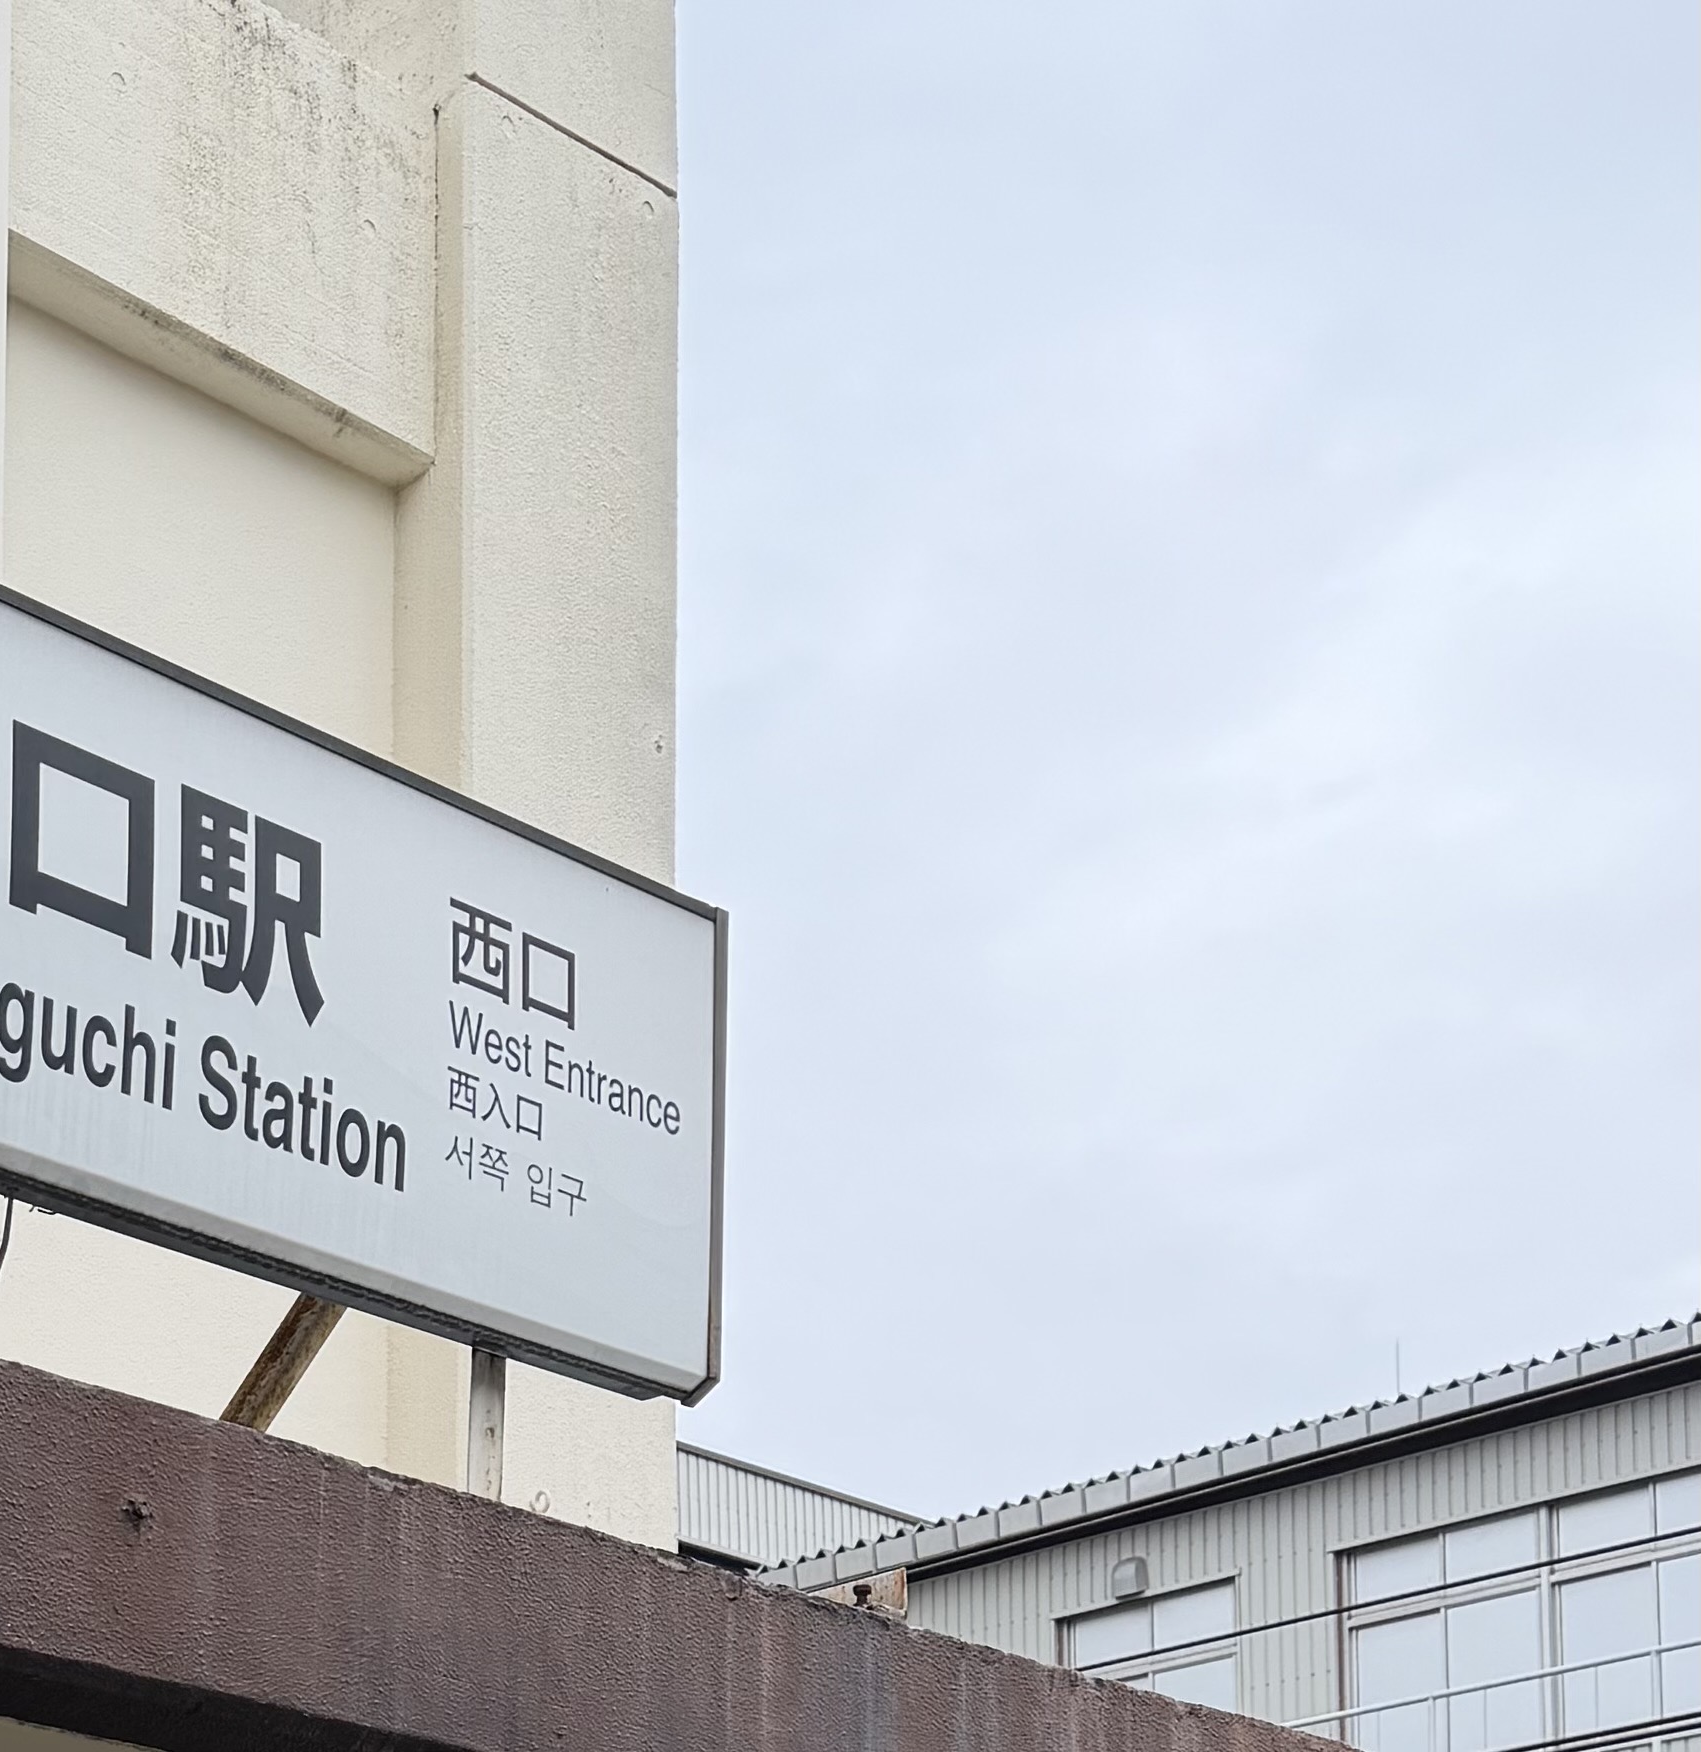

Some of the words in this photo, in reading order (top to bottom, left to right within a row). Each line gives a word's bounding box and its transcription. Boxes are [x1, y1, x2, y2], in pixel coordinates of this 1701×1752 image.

[449, 896, 576, 1031] 西口
[198, 1035, 406, 1192] Station
[447, 1065, 543, 1142] 西入口
[448, 1000, 533, 1078] West
[544, 1039, 682, 1136] Entrance
[444, 1135, 510, 1192] 서쪽
[526, 1162, 588, 1217] 입구
